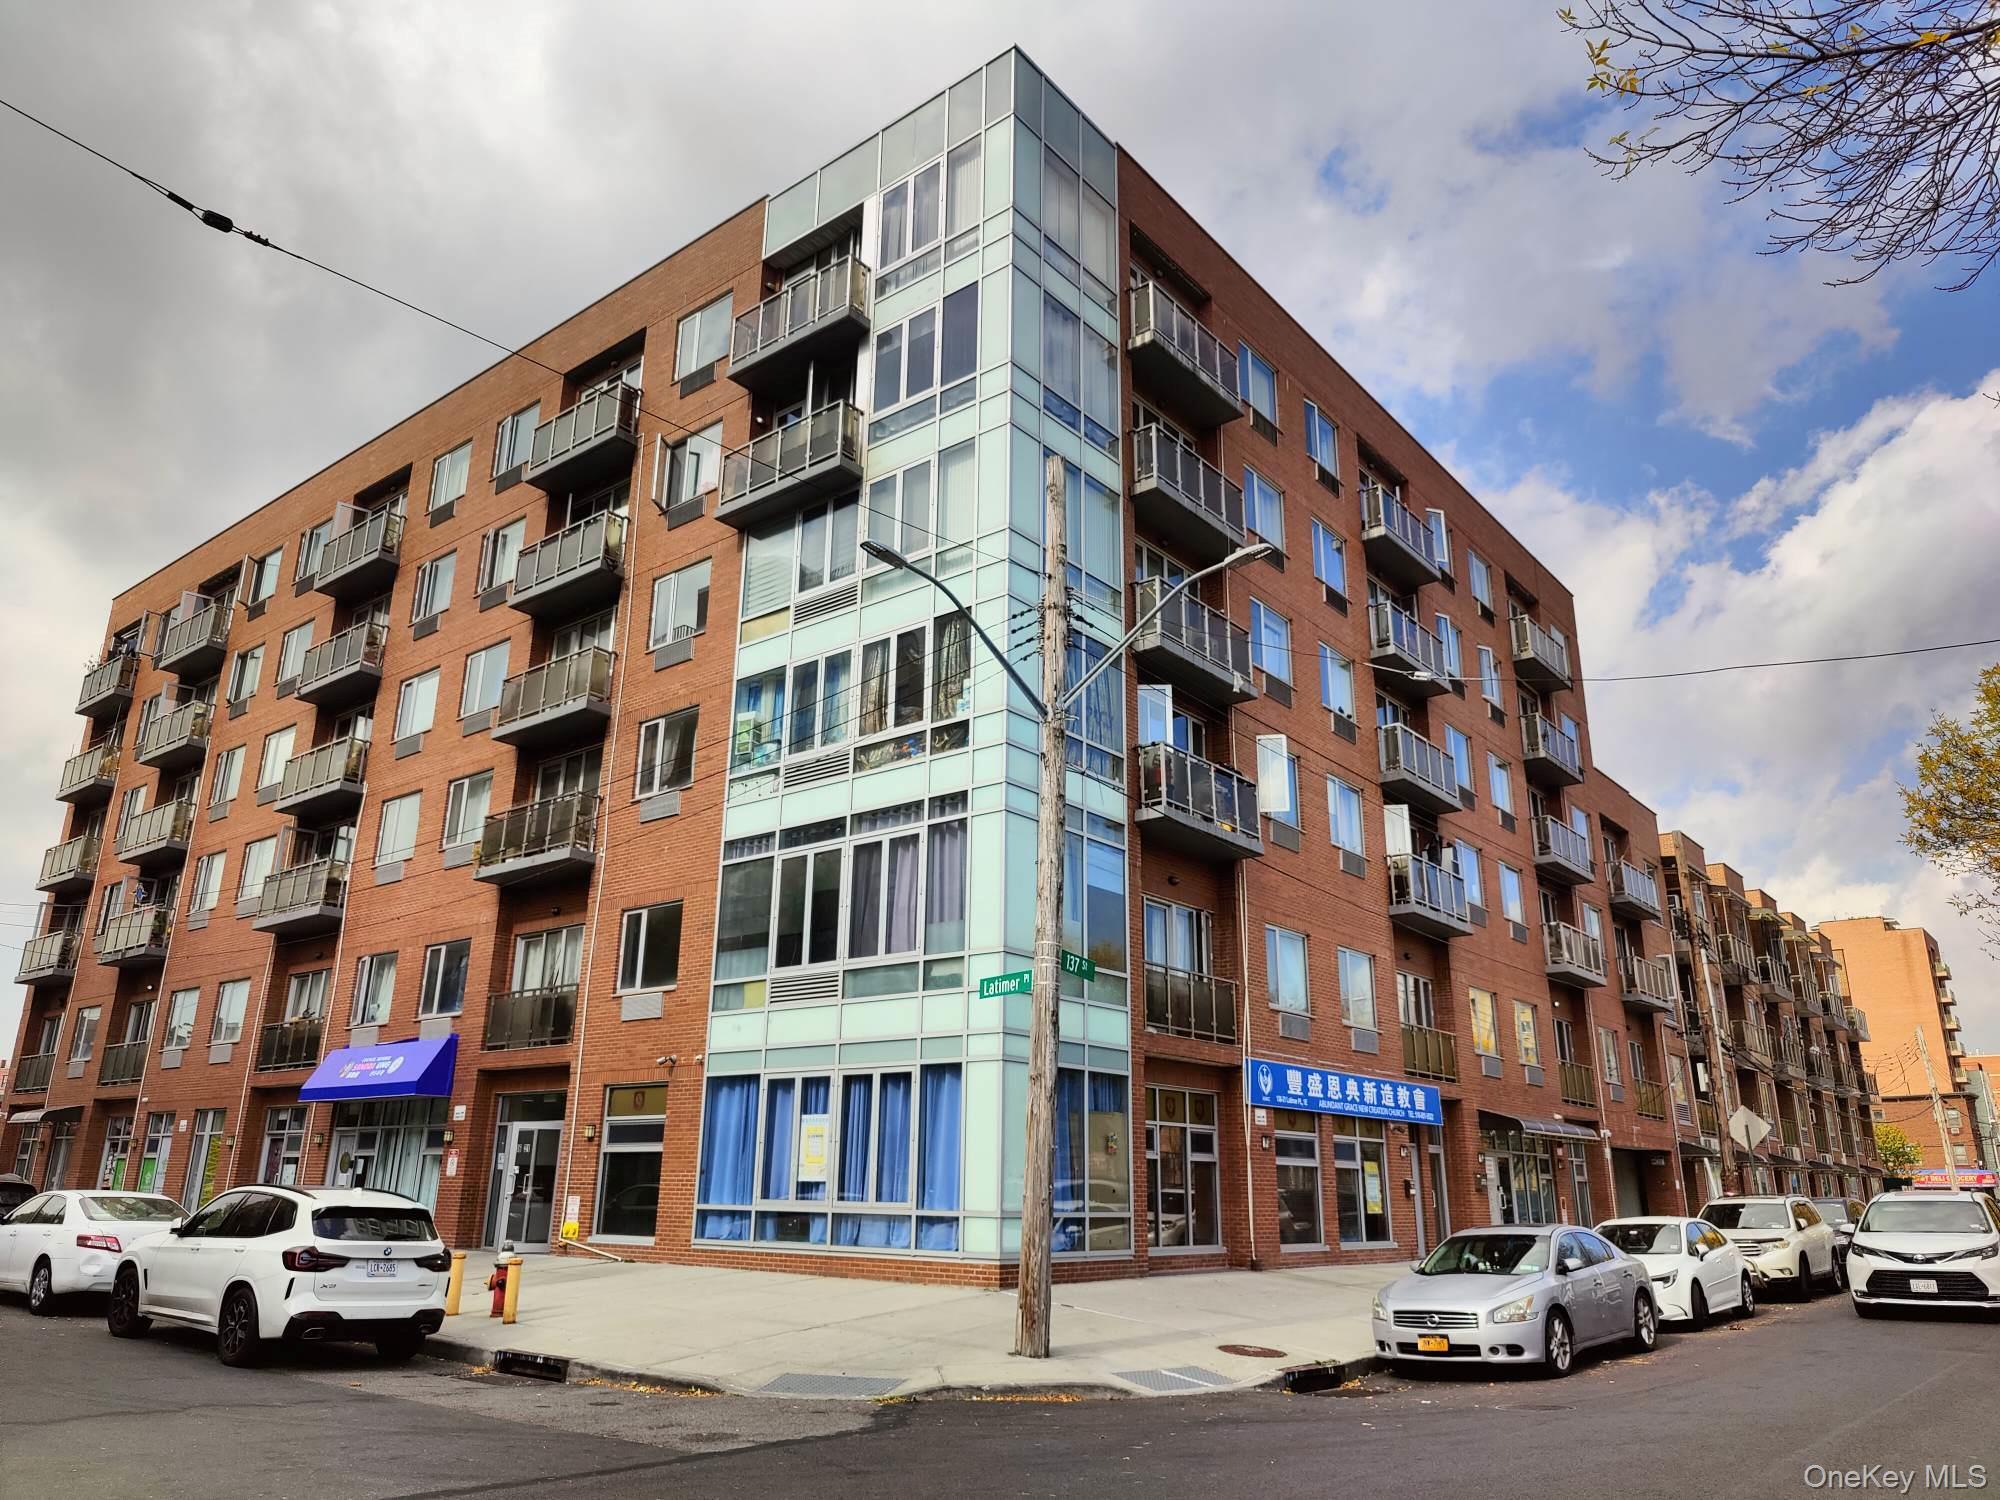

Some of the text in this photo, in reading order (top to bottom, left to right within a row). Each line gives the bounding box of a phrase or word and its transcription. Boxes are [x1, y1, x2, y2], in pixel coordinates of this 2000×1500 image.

[1066, 954, 1080, 973] 137
[983, 977, 1020, 996] Latimer
[1286, 1069, 1426, 1111] 豐盛恩典新造教會
[1319, 1099, 1344, 1110] ABUNDANT
[1344, 1102, 1359, 1112] GRACE
[1359, 1104, 1369, 1113] NEW
[1369, 1105, 1389, 1116] CREATION
[1389, 1107, 1405, 1117] CHURCH
